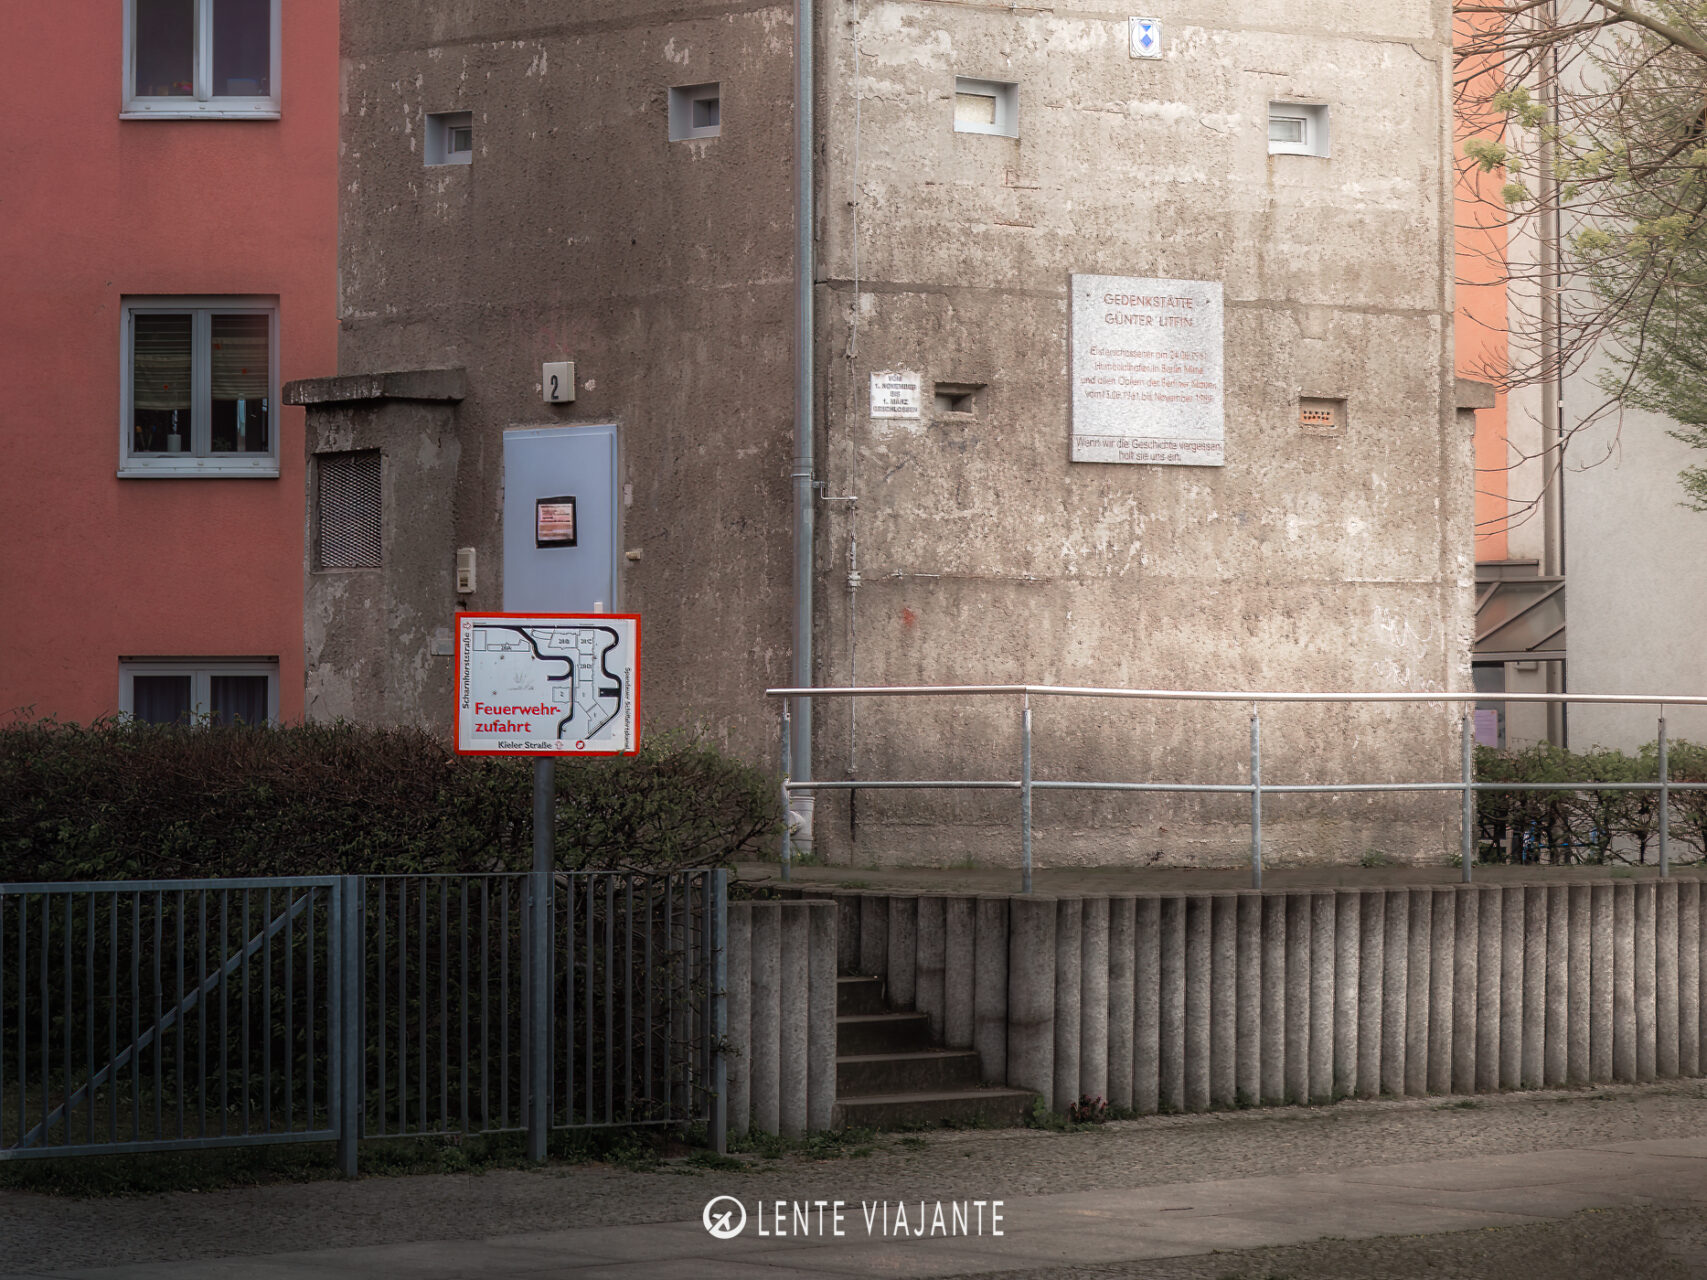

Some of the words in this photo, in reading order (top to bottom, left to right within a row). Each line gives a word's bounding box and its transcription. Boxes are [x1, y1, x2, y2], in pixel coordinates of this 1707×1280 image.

[1103, 293, 1193, 309] GEDENKSTÄTTE
[1104, 311, 1152, 327] GÜNTER
[551, 374, 559, 400] 2
[1080, 376, 1096, 385] und
[1147, 378, 1160, 387] der
[1076, 437, 1100, 448] Wenn
[1102, 439, 1114, 448] wir
[1117, 438, 1129, 449] die
[1132, 439, 1177, 450] Geschichte
[1119, 450, 1135, 460] holt
[1136, 451, 1149, 461] sie
[1151, 453, 1165, 461] uns
[462, 632, 472, 709] Scharnhorststraße
[475, 702, 561, 716] Feuerwehr-
[475, 719, 532, 733] zufahrt
[498, 741, 523, 749] Kieler
[524, 741, 552, 750] Straße
